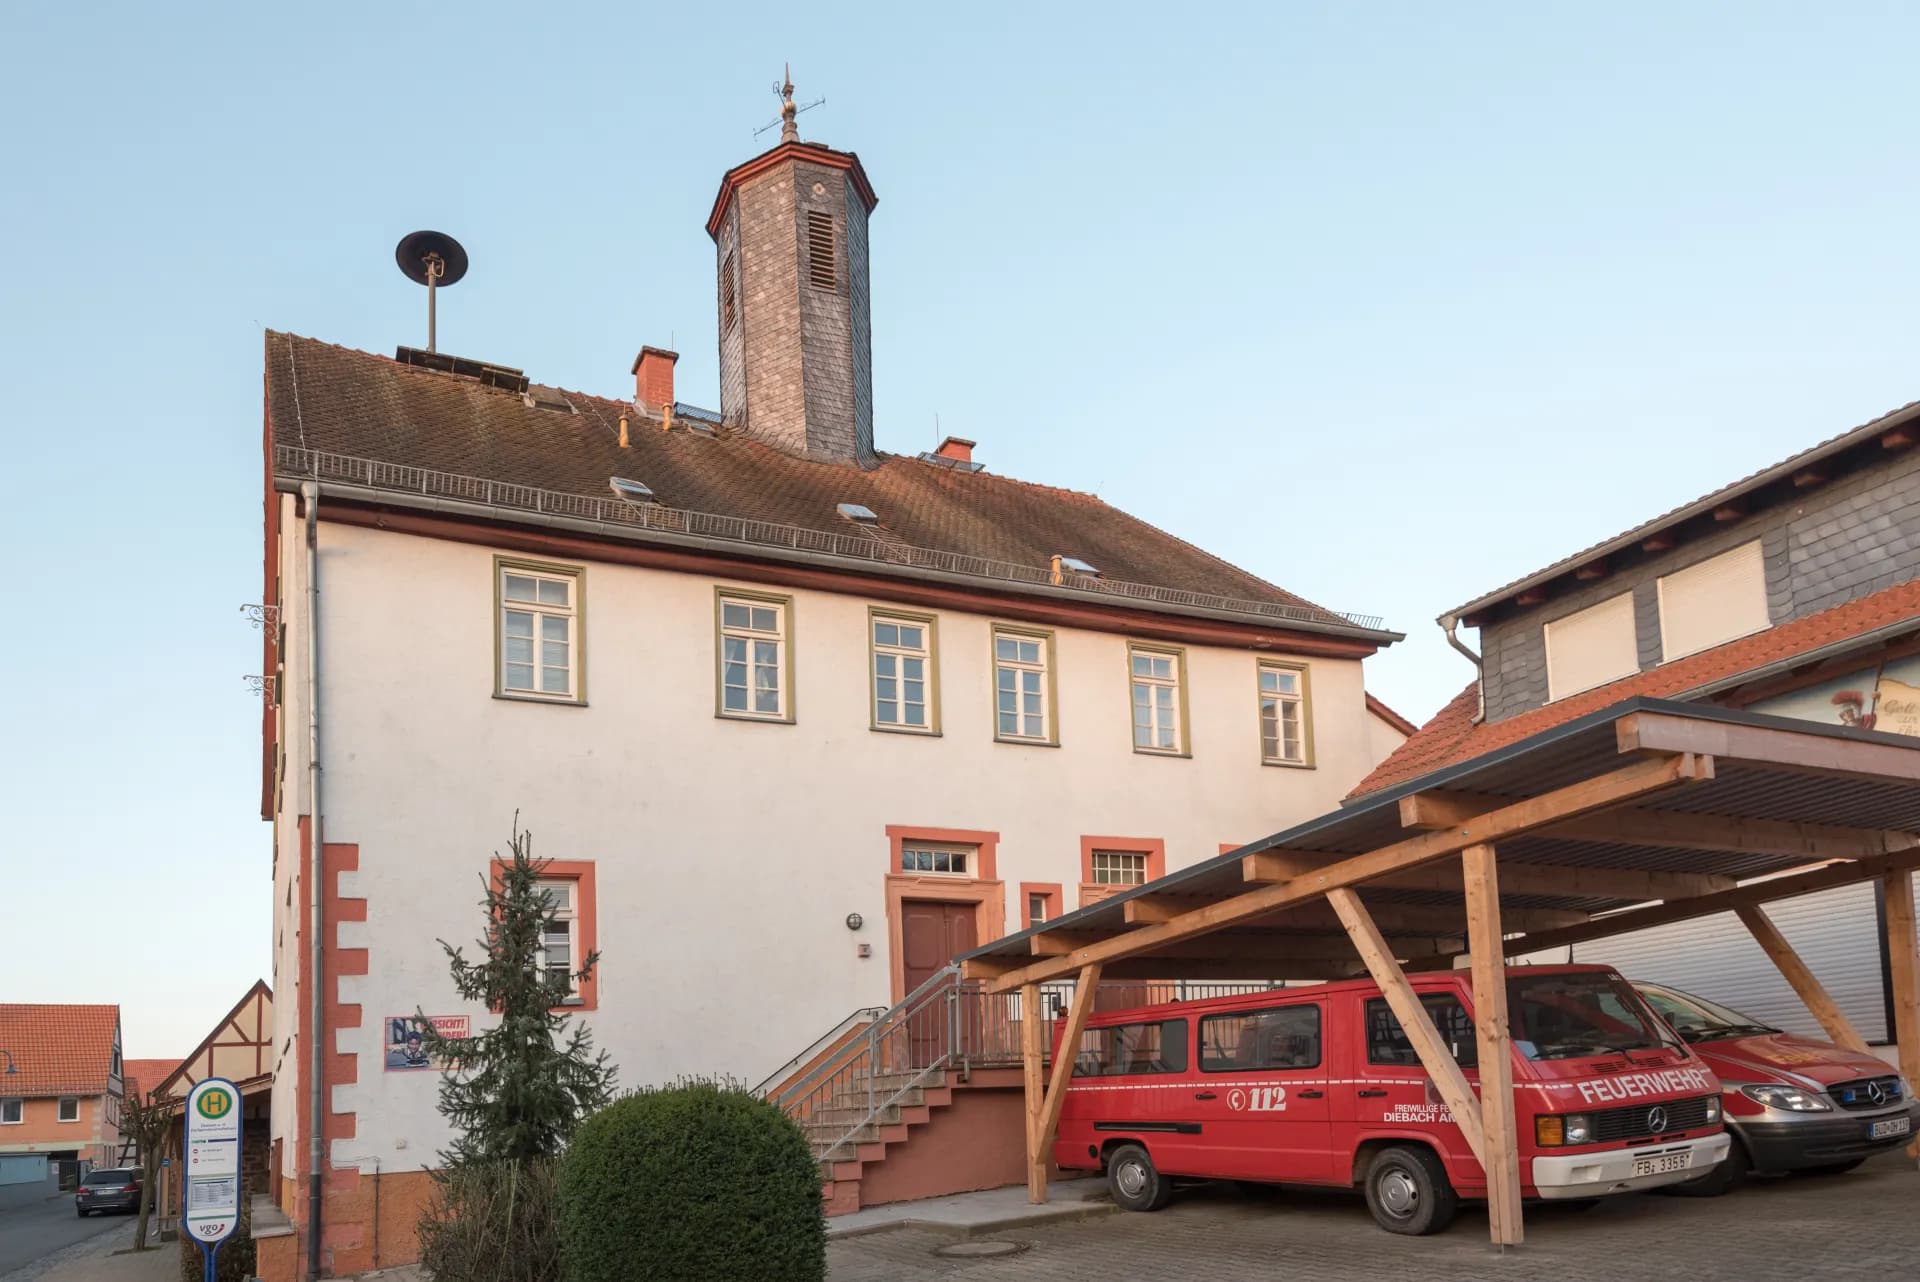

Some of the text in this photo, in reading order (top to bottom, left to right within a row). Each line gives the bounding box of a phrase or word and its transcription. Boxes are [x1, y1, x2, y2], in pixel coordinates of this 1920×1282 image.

[1576, 1068, 1710, 1104] FEUERWEHR
[207, 1094, 222, 1113] H
[1248, 1087, 1287, 1111] 112
[1394, 1104, 1438, 1113] FREIWILLIGE
[1383, 1112, 1435, 1122] DIEBACH
[199, 1224, 218, 1235] vgo
